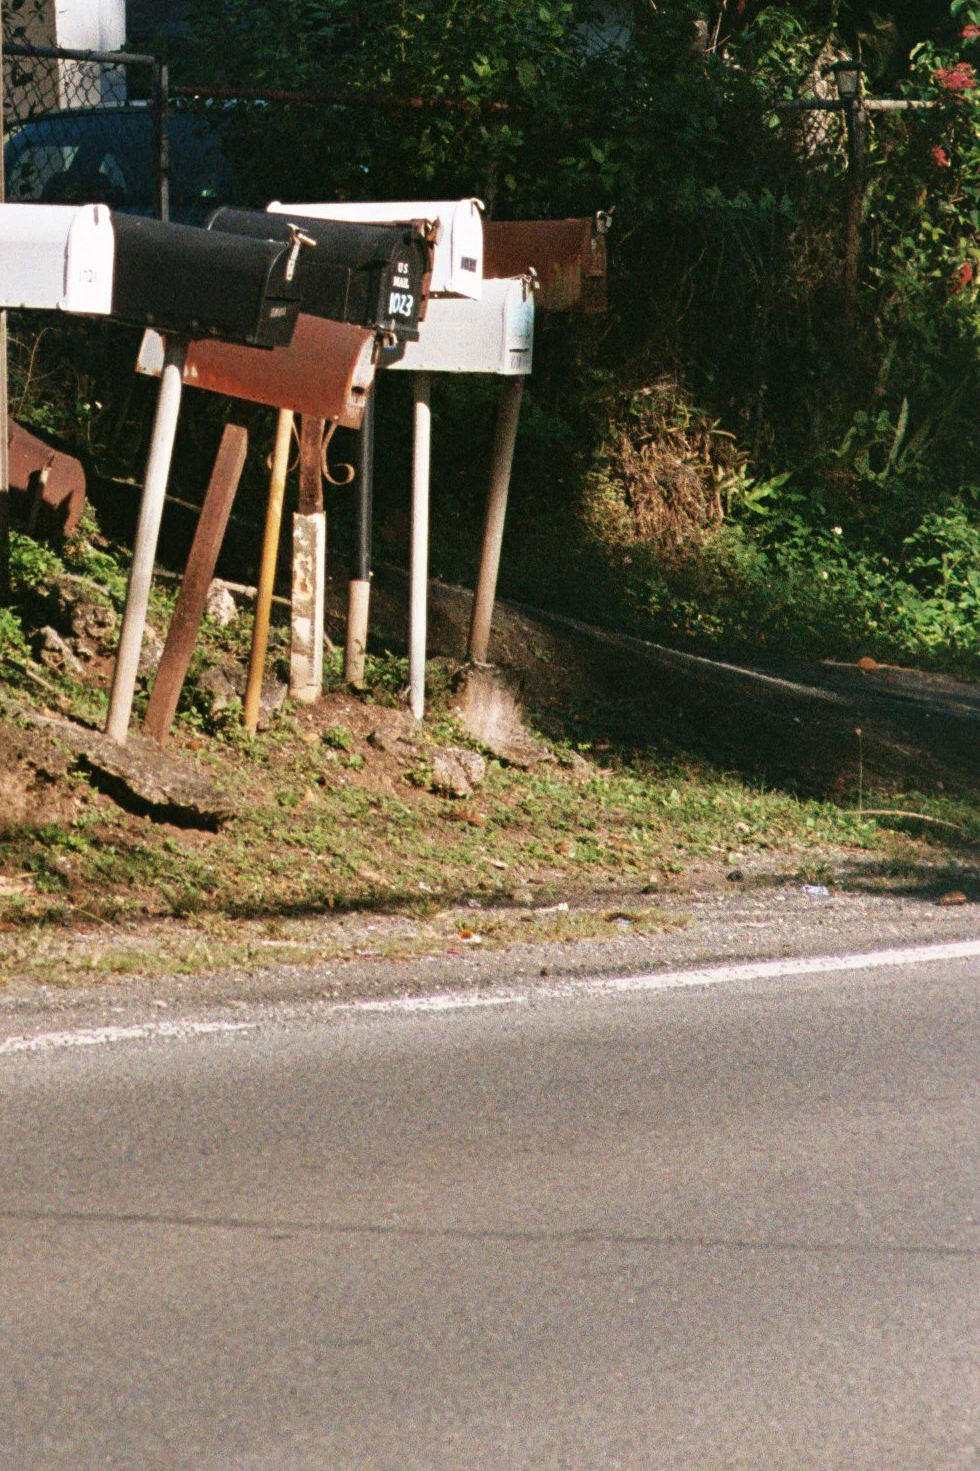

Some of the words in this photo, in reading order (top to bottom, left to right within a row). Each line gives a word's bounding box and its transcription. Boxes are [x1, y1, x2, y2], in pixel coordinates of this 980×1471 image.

[397, 262, 409, 274] US
[393, 276, 410, 289] MAIL
[388, 292, 414, 317] 1023
